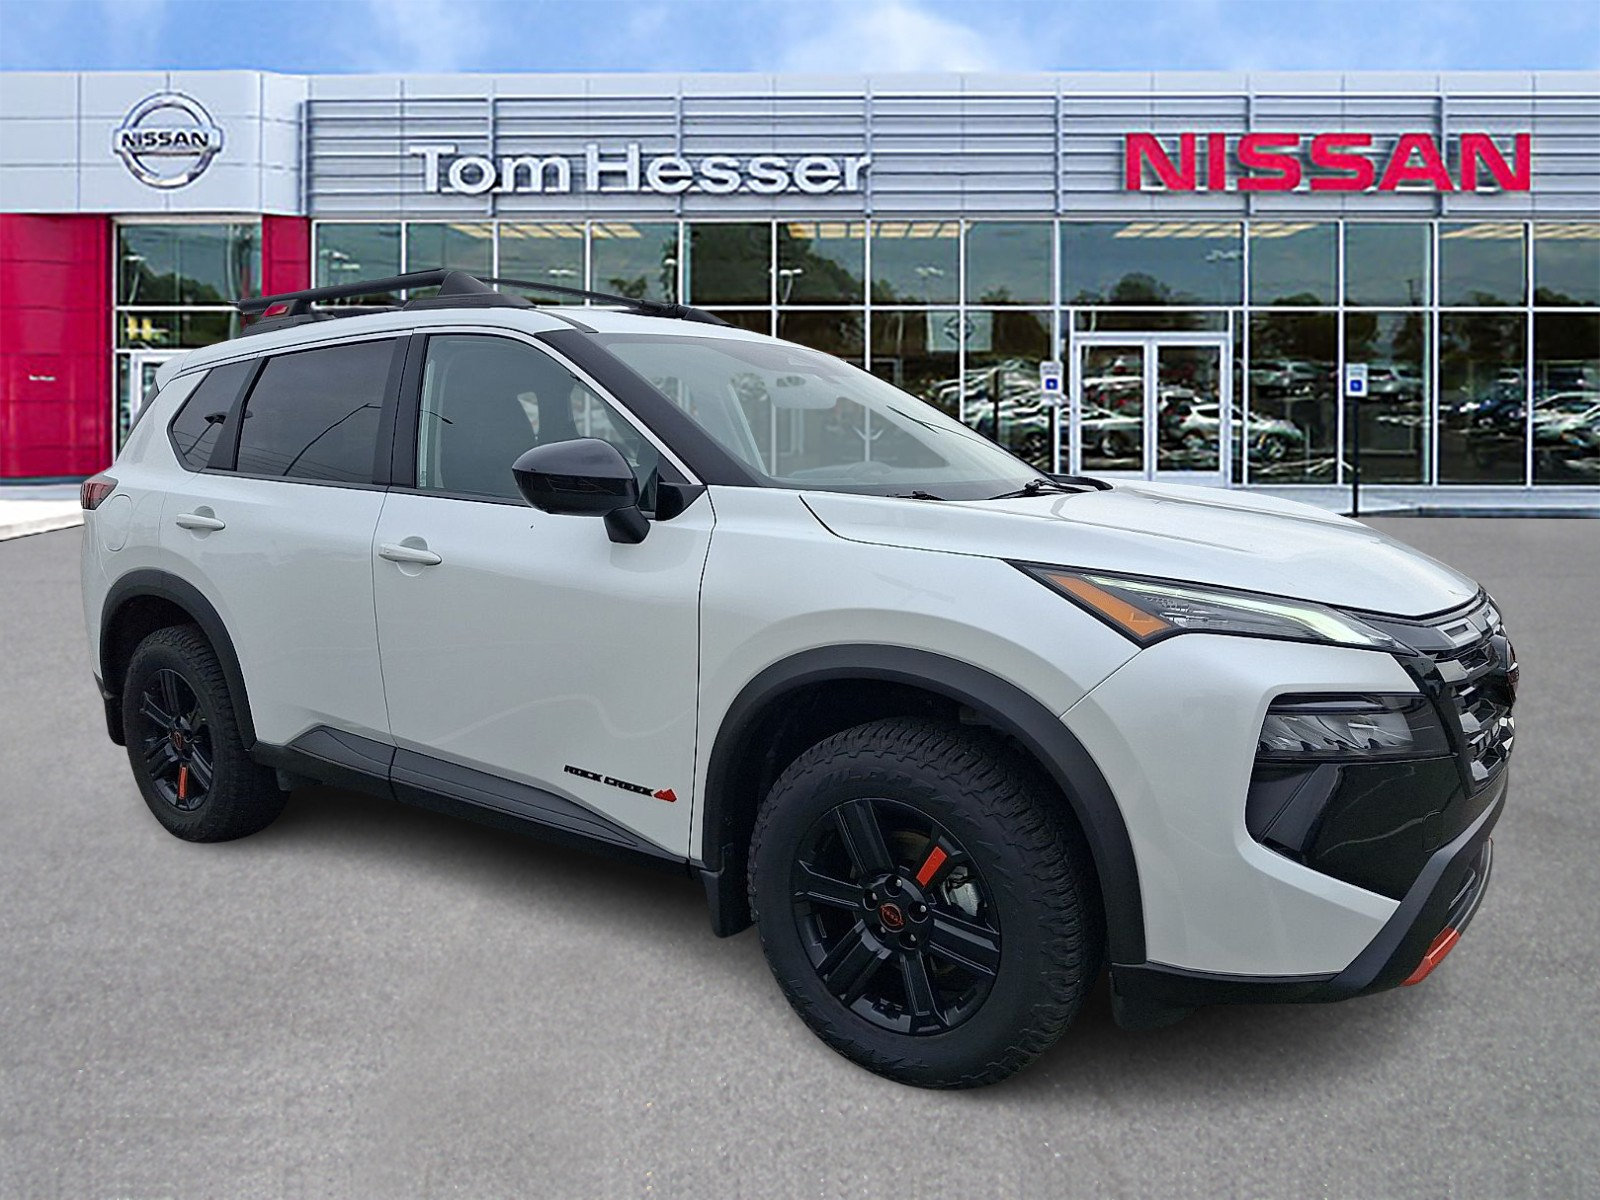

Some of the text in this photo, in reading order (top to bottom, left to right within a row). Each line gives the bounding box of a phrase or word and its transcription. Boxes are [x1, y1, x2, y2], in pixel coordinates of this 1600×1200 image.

[121, 131, 209, 147] NISSAN
[409, 143, 871, 195] Tom Hesser
[1125, 132, 1531, 192] NISSAN
[563, 764, 654, 797] ROCK CREEK
